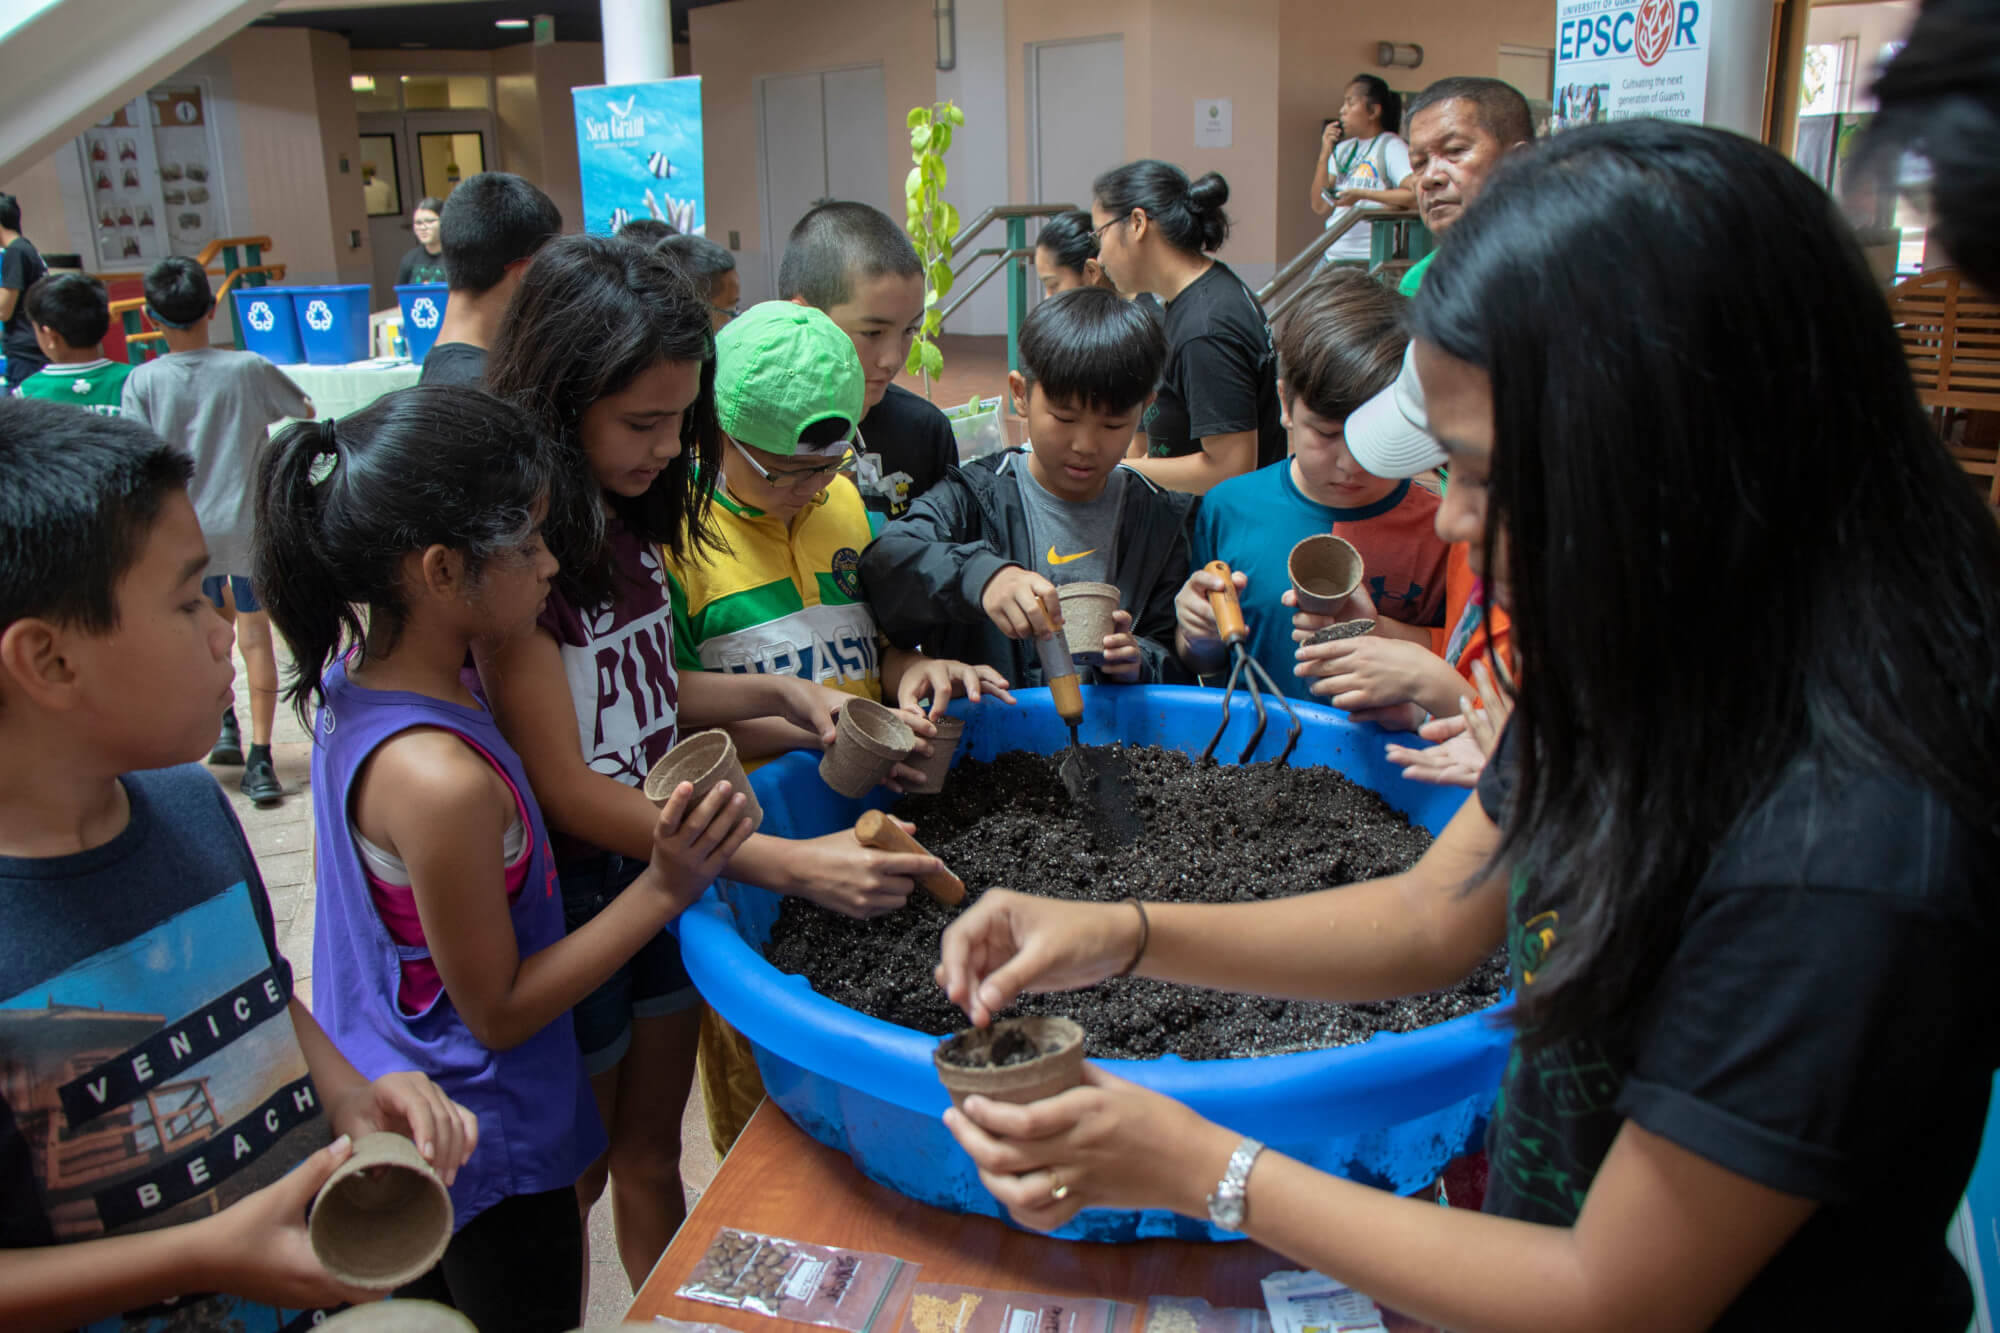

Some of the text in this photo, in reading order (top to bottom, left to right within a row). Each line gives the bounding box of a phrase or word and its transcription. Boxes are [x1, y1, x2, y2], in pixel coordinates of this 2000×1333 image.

[1562, 0, 1601, 16] UNIVERSITY
[1622, 75, 1683, 90] Cultivating the next
[1617, 91, 1685, 107] generation of Guam's
[586, 114, 645, 140] Sea Grant
[594, 616, 678, 751] PIN
[87, 978, 280, 1103] VENICE
[136, 1086, 315, 1208] BEACH
